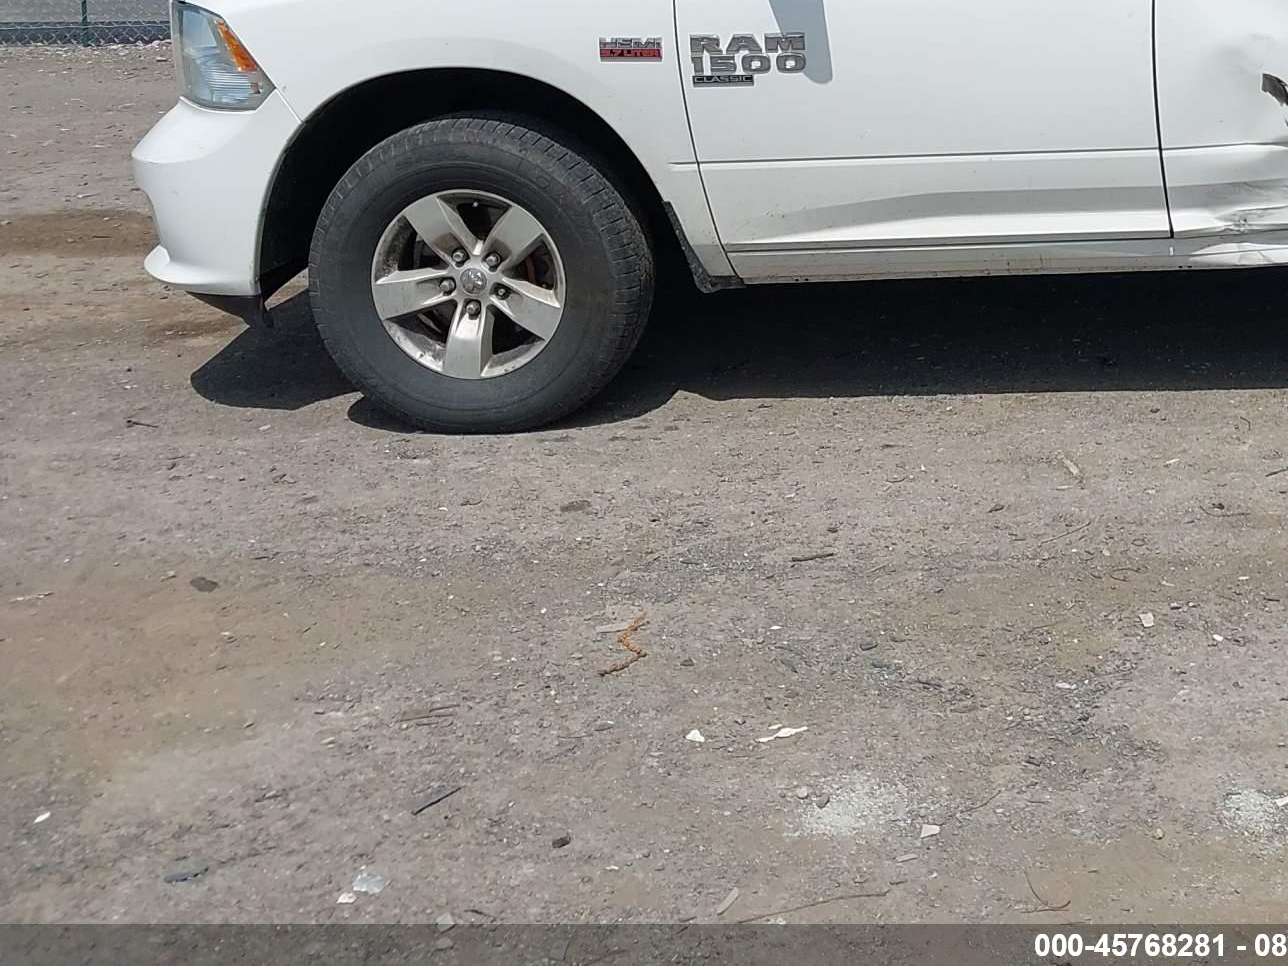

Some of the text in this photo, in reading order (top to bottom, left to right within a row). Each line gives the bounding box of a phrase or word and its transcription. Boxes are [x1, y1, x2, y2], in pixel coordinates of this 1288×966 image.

[599, 37, 662, 49] HEMI
[690, 33, 806, 54] RAM
[690, 53, 806, 74] 1500
[693, 75, 754, 84] CLASSIC
